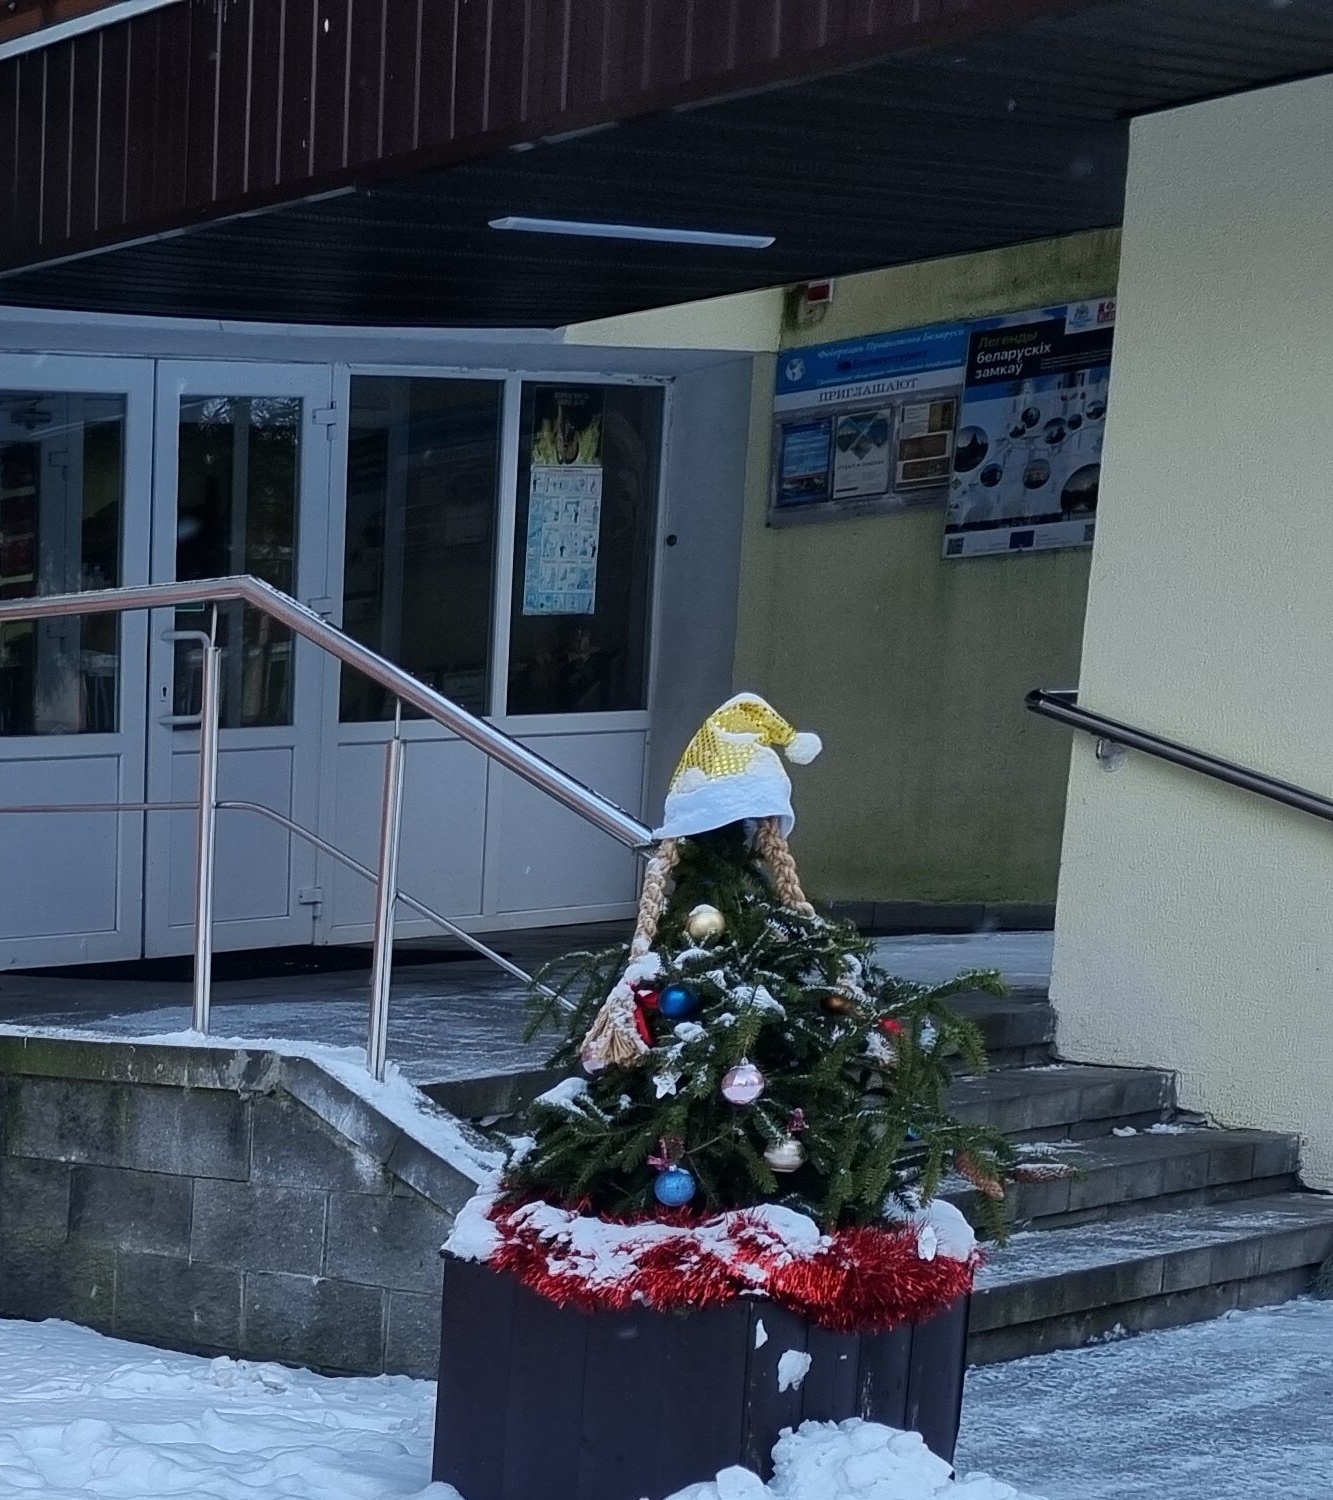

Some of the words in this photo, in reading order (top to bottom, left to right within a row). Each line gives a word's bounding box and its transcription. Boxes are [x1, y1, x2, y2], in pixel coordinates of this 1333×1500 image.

[978, 330, 1038, 348] Легенды
[976, 341, 1052, 364] беларускіх
[974, 359, 1023, 379] замкаў
[819, 378, 919, 402] ПРИГЛАШАЮТ
